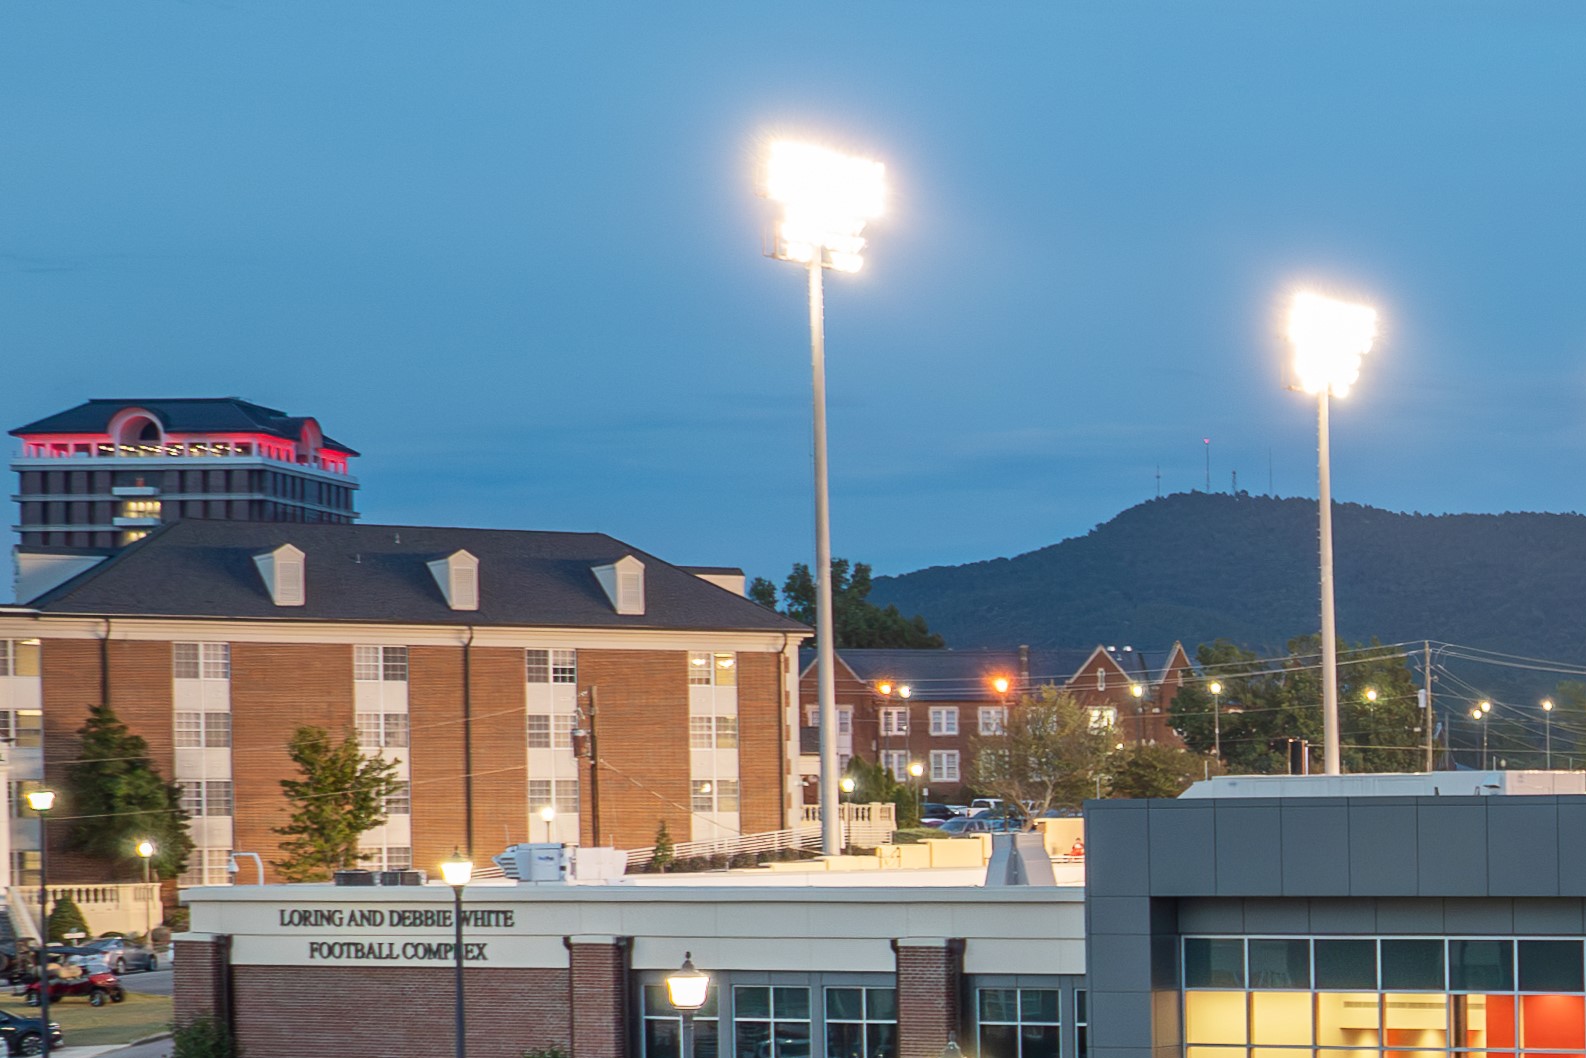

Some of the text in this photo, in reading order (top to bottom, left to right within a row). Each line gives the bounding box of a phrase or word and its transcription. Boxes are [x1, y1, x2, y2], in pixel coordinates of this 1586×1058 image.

[279, 908, 515, 928] LORING AND DEBBIE WHITE
[308, 941, 488, 961] FOOTBALL COMPEX
